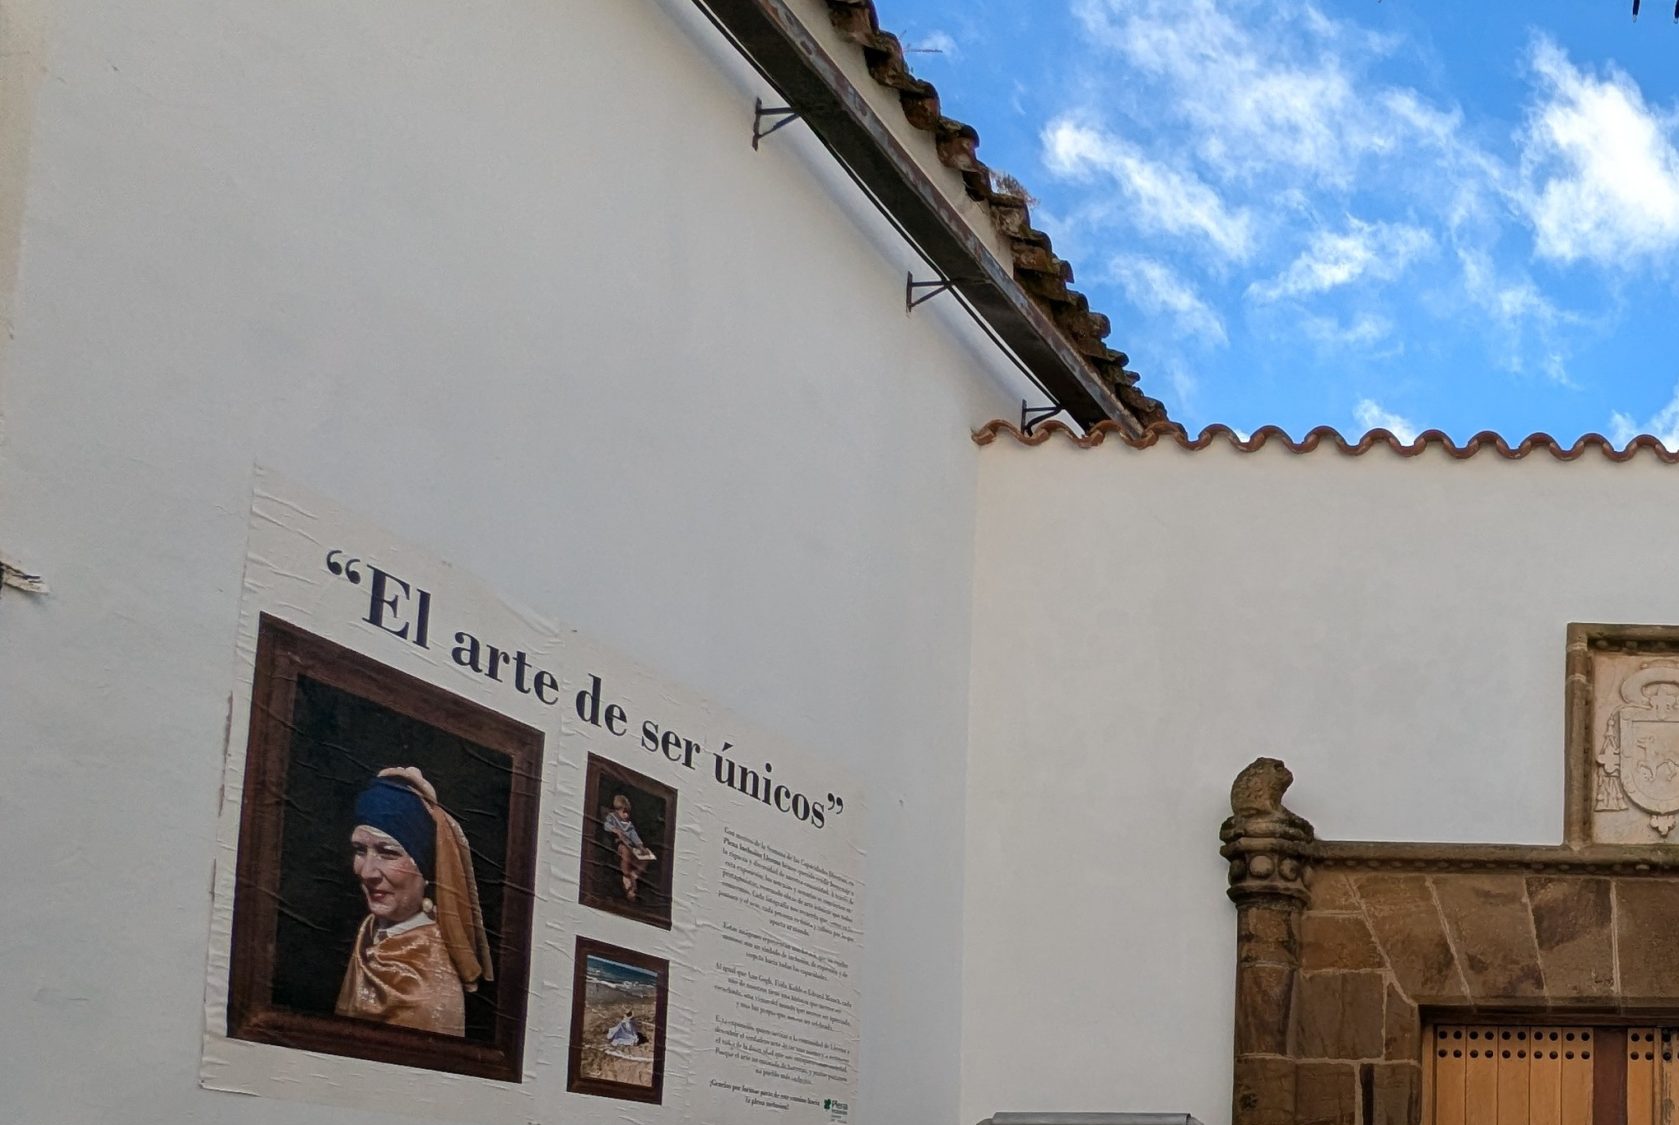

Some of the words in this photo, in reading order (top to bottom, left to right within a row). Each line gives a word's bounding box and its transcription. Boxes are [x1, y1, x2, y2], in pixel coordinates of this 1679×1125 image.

[451, 631, 559, 706] arte
[575, 673, 628, 736] de
[641, 720, 701, 770] ser
[712, 742, 844, 829] únicos”
